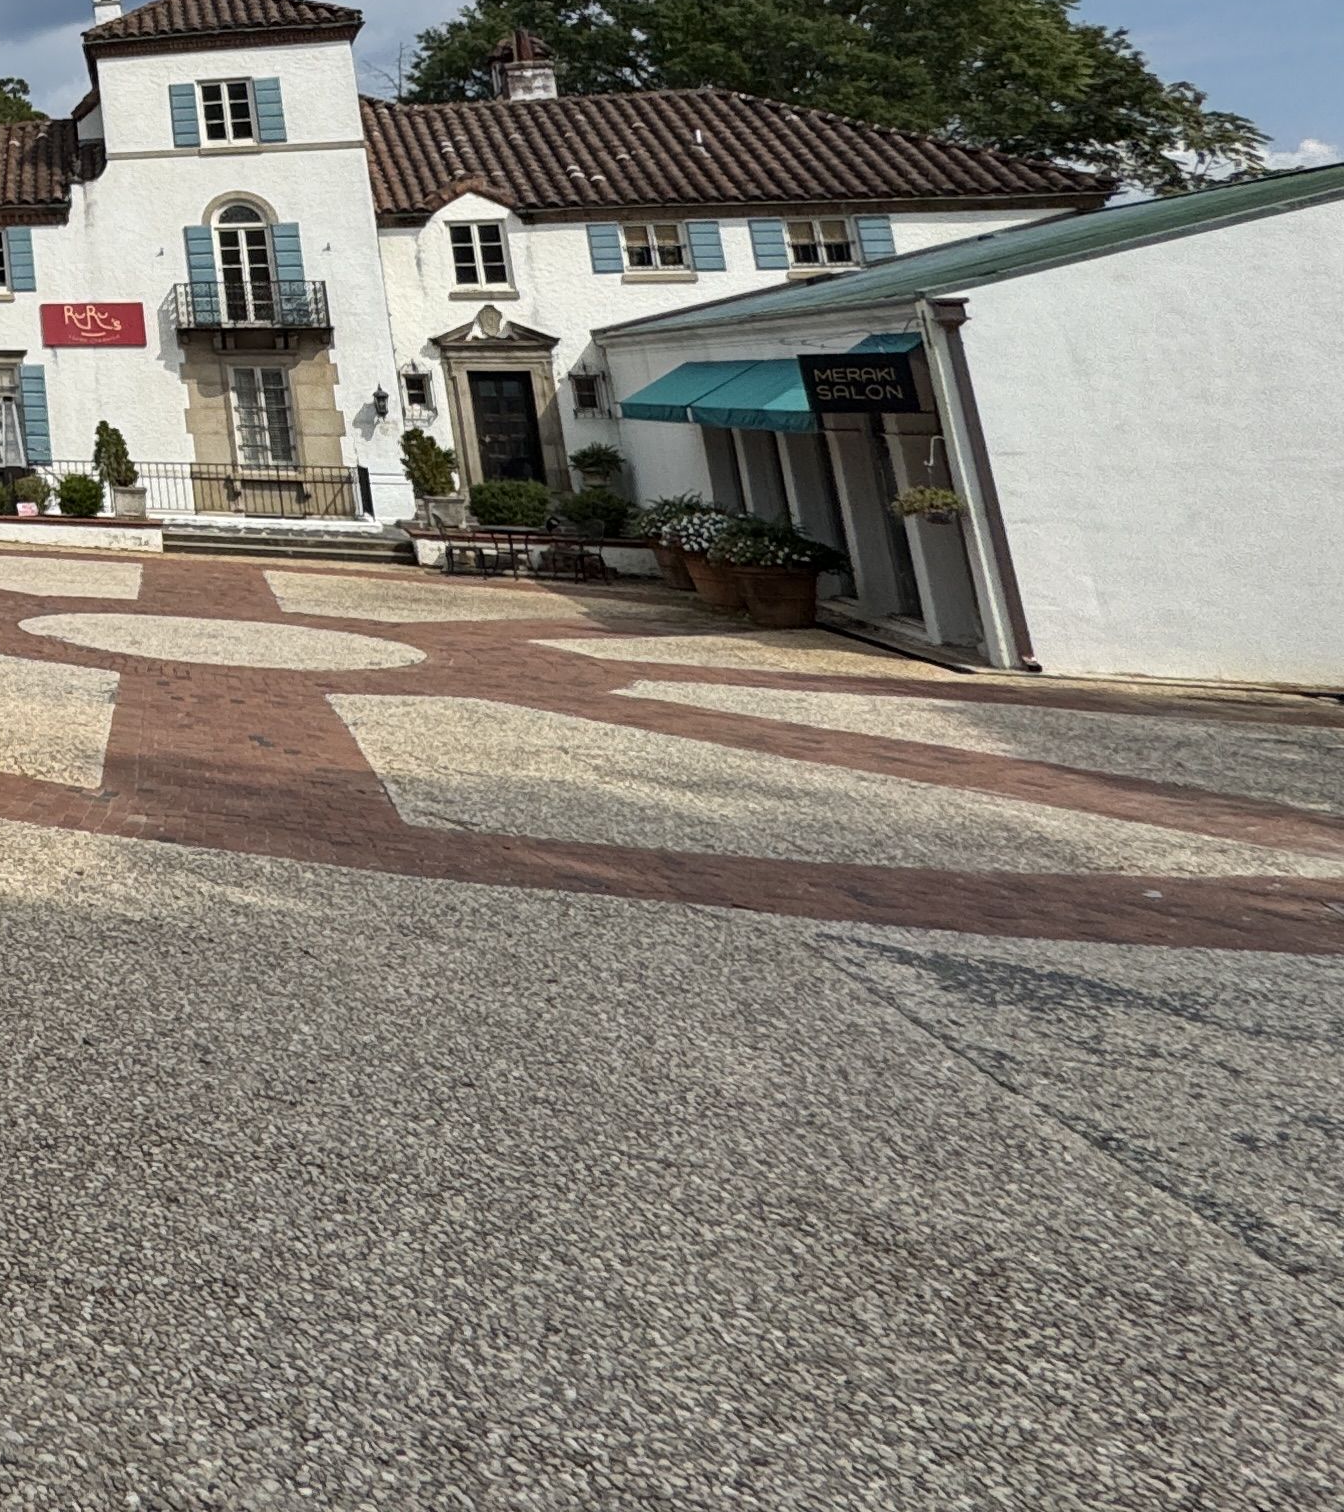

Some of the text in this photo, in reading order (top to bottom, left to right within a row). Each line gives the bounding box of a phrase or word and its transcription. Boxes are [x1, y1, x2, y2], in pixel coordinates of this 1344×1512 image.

[64, 305, 122, 331] RuRu's
[814, 367, 897, 382] MERAKI
[816, 384, 904, 400] SALON
